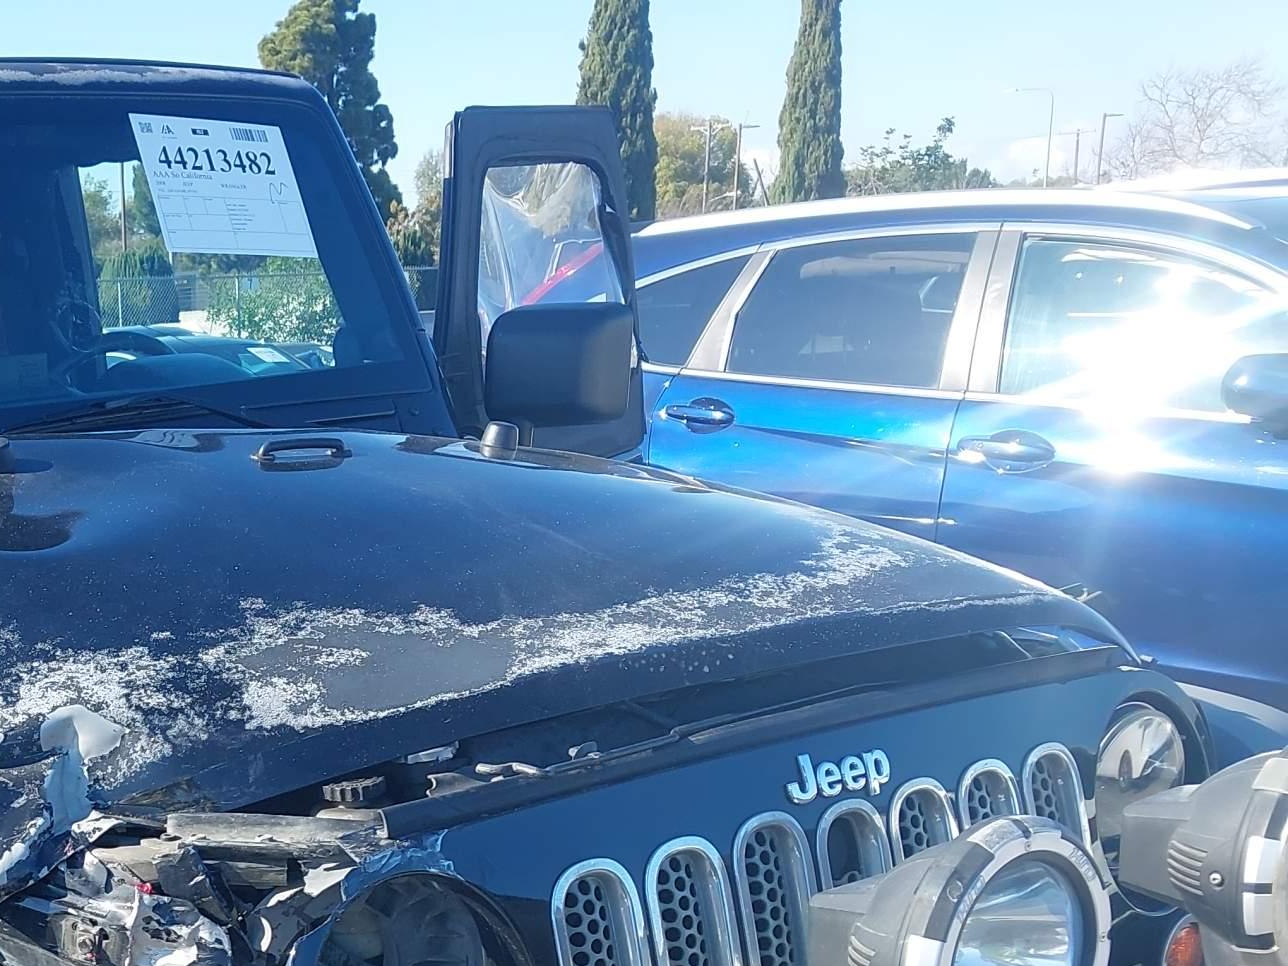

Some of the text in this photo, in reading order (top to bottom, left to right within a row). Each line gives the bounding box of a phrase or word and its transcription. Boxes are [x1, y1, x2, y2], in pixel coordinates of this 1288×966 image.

[153, 170, 170, 178] AAA
[181, 171, 213, 180] California
[158, 145, 276, 175] 44213482
[785, 749, 890, 804] Jeep
